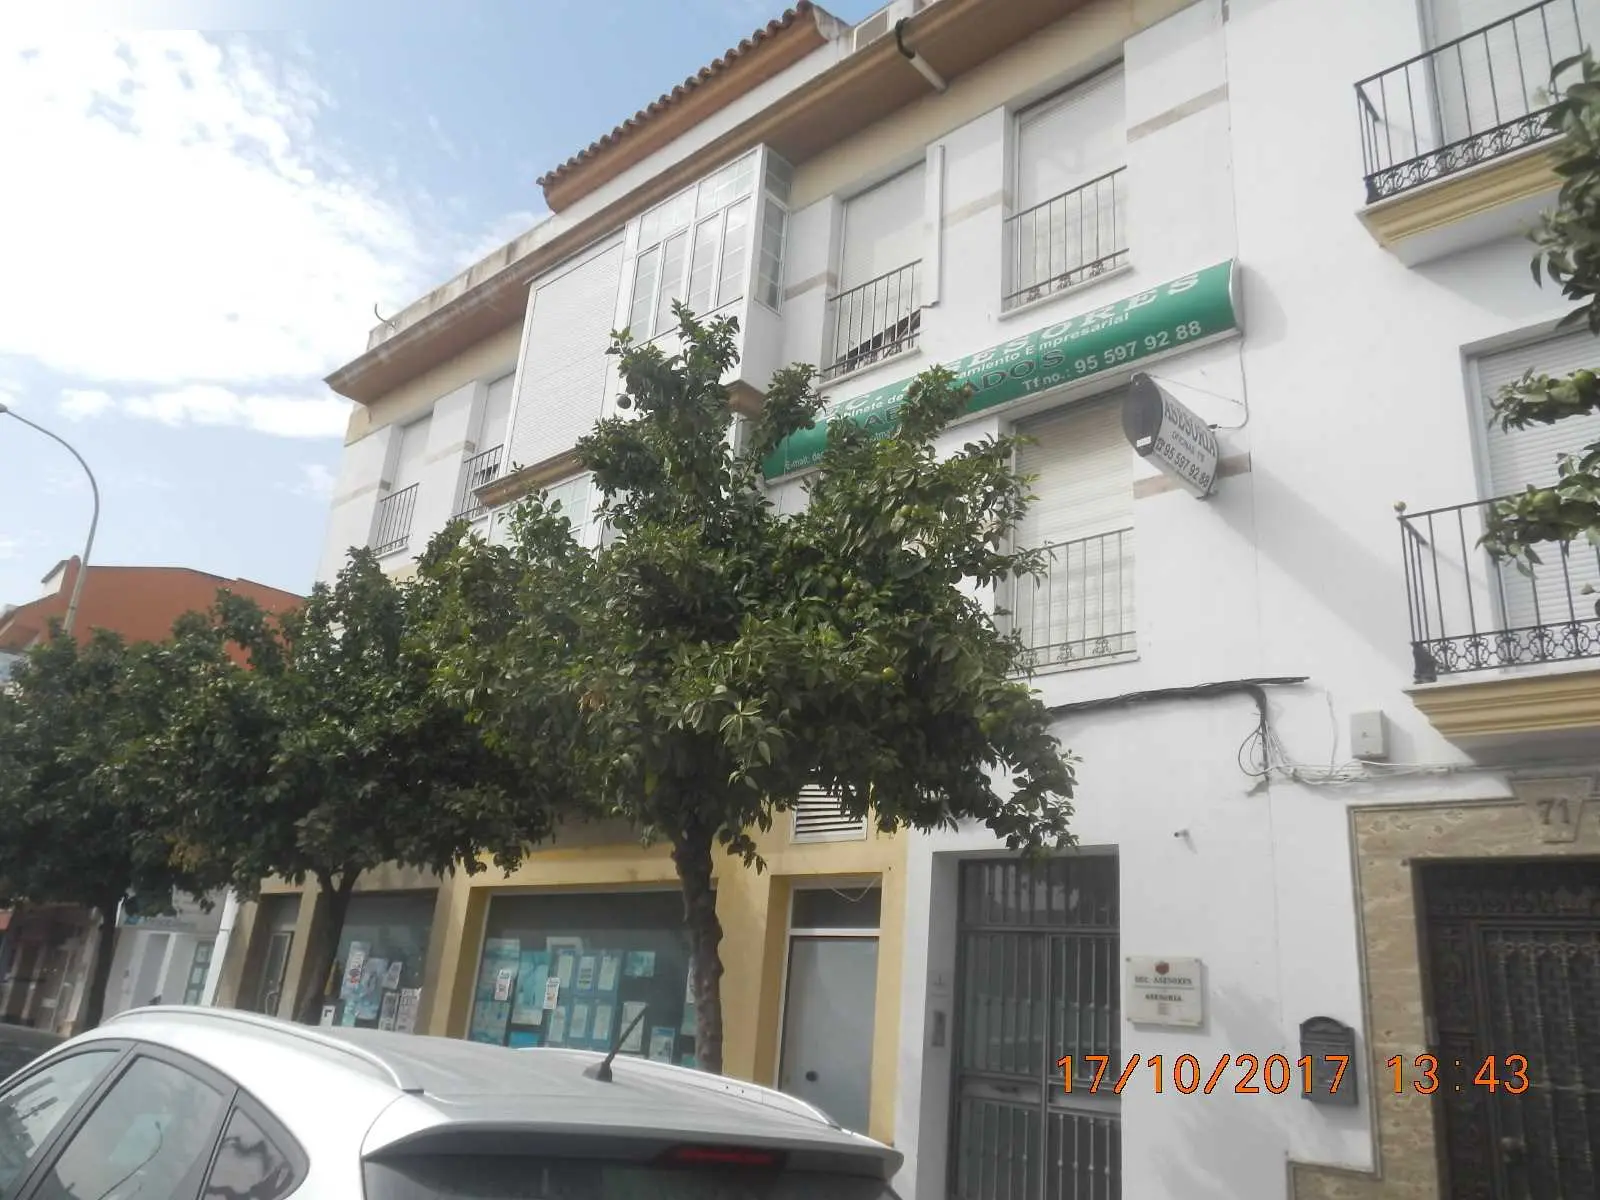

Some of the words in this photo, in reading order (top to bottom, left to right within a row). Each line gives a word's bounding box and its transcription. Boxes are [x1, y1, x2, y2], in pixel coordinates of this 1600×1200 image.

[1074, 354, 1099, 374] 95
[1103, 340, 1138, 365] 597
[1144, 330, 1171, 351] 92
[1175, 319, 1202, 341] 88
[1163, 442, 1175, 460] 95
[1174, 451, 1191, 471] 597
[1188, 463, 1200, 481] 92
[1536, 797, 1570, 826] 71
